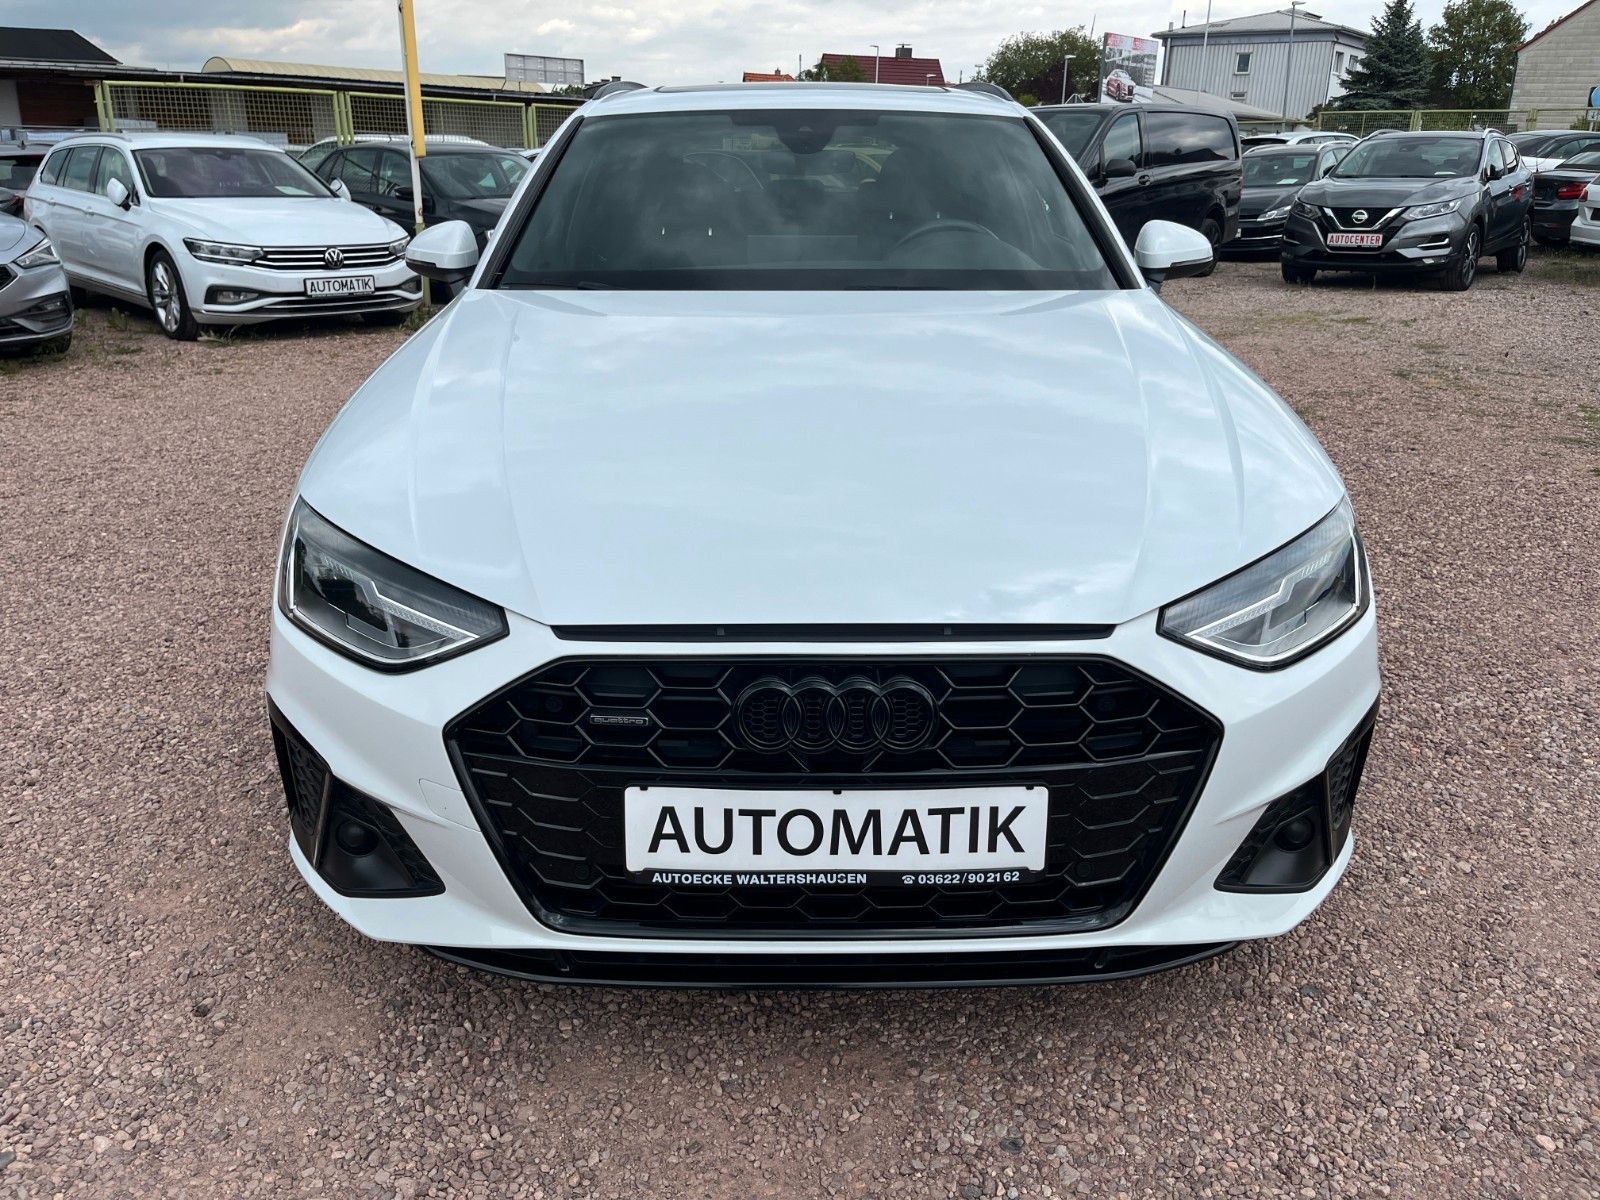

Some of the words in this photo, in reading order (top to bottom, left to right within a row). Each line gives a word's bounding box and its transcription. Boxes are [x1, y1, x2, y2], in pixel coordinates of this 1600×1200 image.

[1329, 234, 1381, 244] AUTOCENTER
[310, 279, 372, 293] AUTOMATIK
[594, 717, 644, 726] quattro
[647, 805, 1027, 856] AUTOMATIK
[652, 873, 733, 885] AUTOECKE
[736, 873, 867, 885] WALTERSHAUSEN
